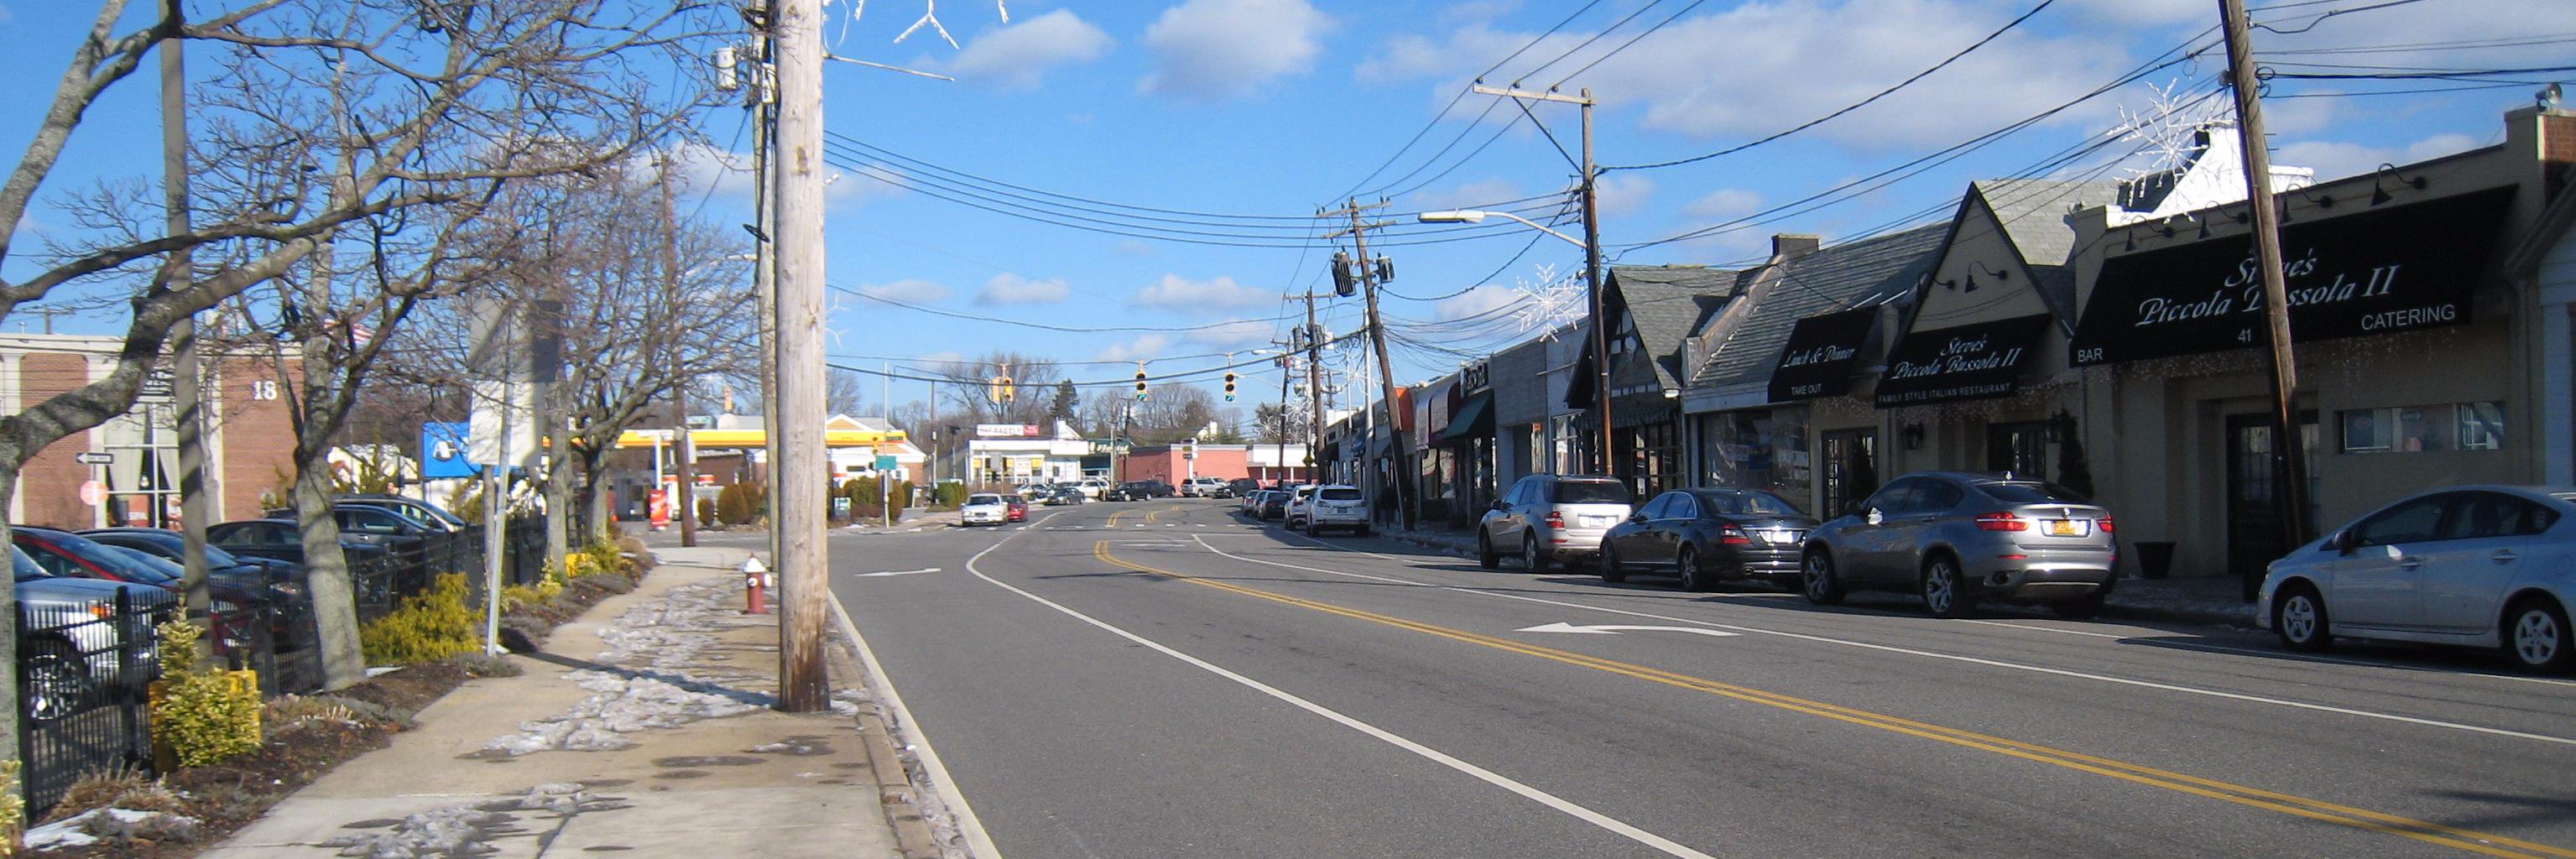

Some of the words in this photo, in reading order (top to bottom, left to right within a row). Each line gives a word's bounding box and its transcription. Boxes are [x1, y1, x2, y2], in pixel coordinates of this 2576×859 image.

[2224, 247, 2318, 287] Ste's
[2135, 289, 2233, 327] Piccola
[2241, 273, 2357, 313] Bssola
[2360, 264, 2401, 297] II
[2361, 304, 2455, 331] CATERING
[1940, 333, 1988, 357] Steve's
[2238, 328, 2252, 343] 41
[1810, 347, 1822, 363] &
[1890, 357, 1942, 380] Piccola
[1945, 350, 2001, 373] Bussola
[2000, 347, 2023, 367] II
[2078, 347, 2104, 363] BAR
[253, 380, 278, 400] 18
[1791, 385, 1807, 396] TAKE
[1807, 383, 1822, 394] OUT
[1878, 394, 1903, 404] FAMILY
[1904, 390, 1927, 402] STYLE
[1929, 387, 1958, 400] ITALIAN
[1958, 383, 2010, 397] RESTAURANT
[1096, 444, 1129, 452] Floist
